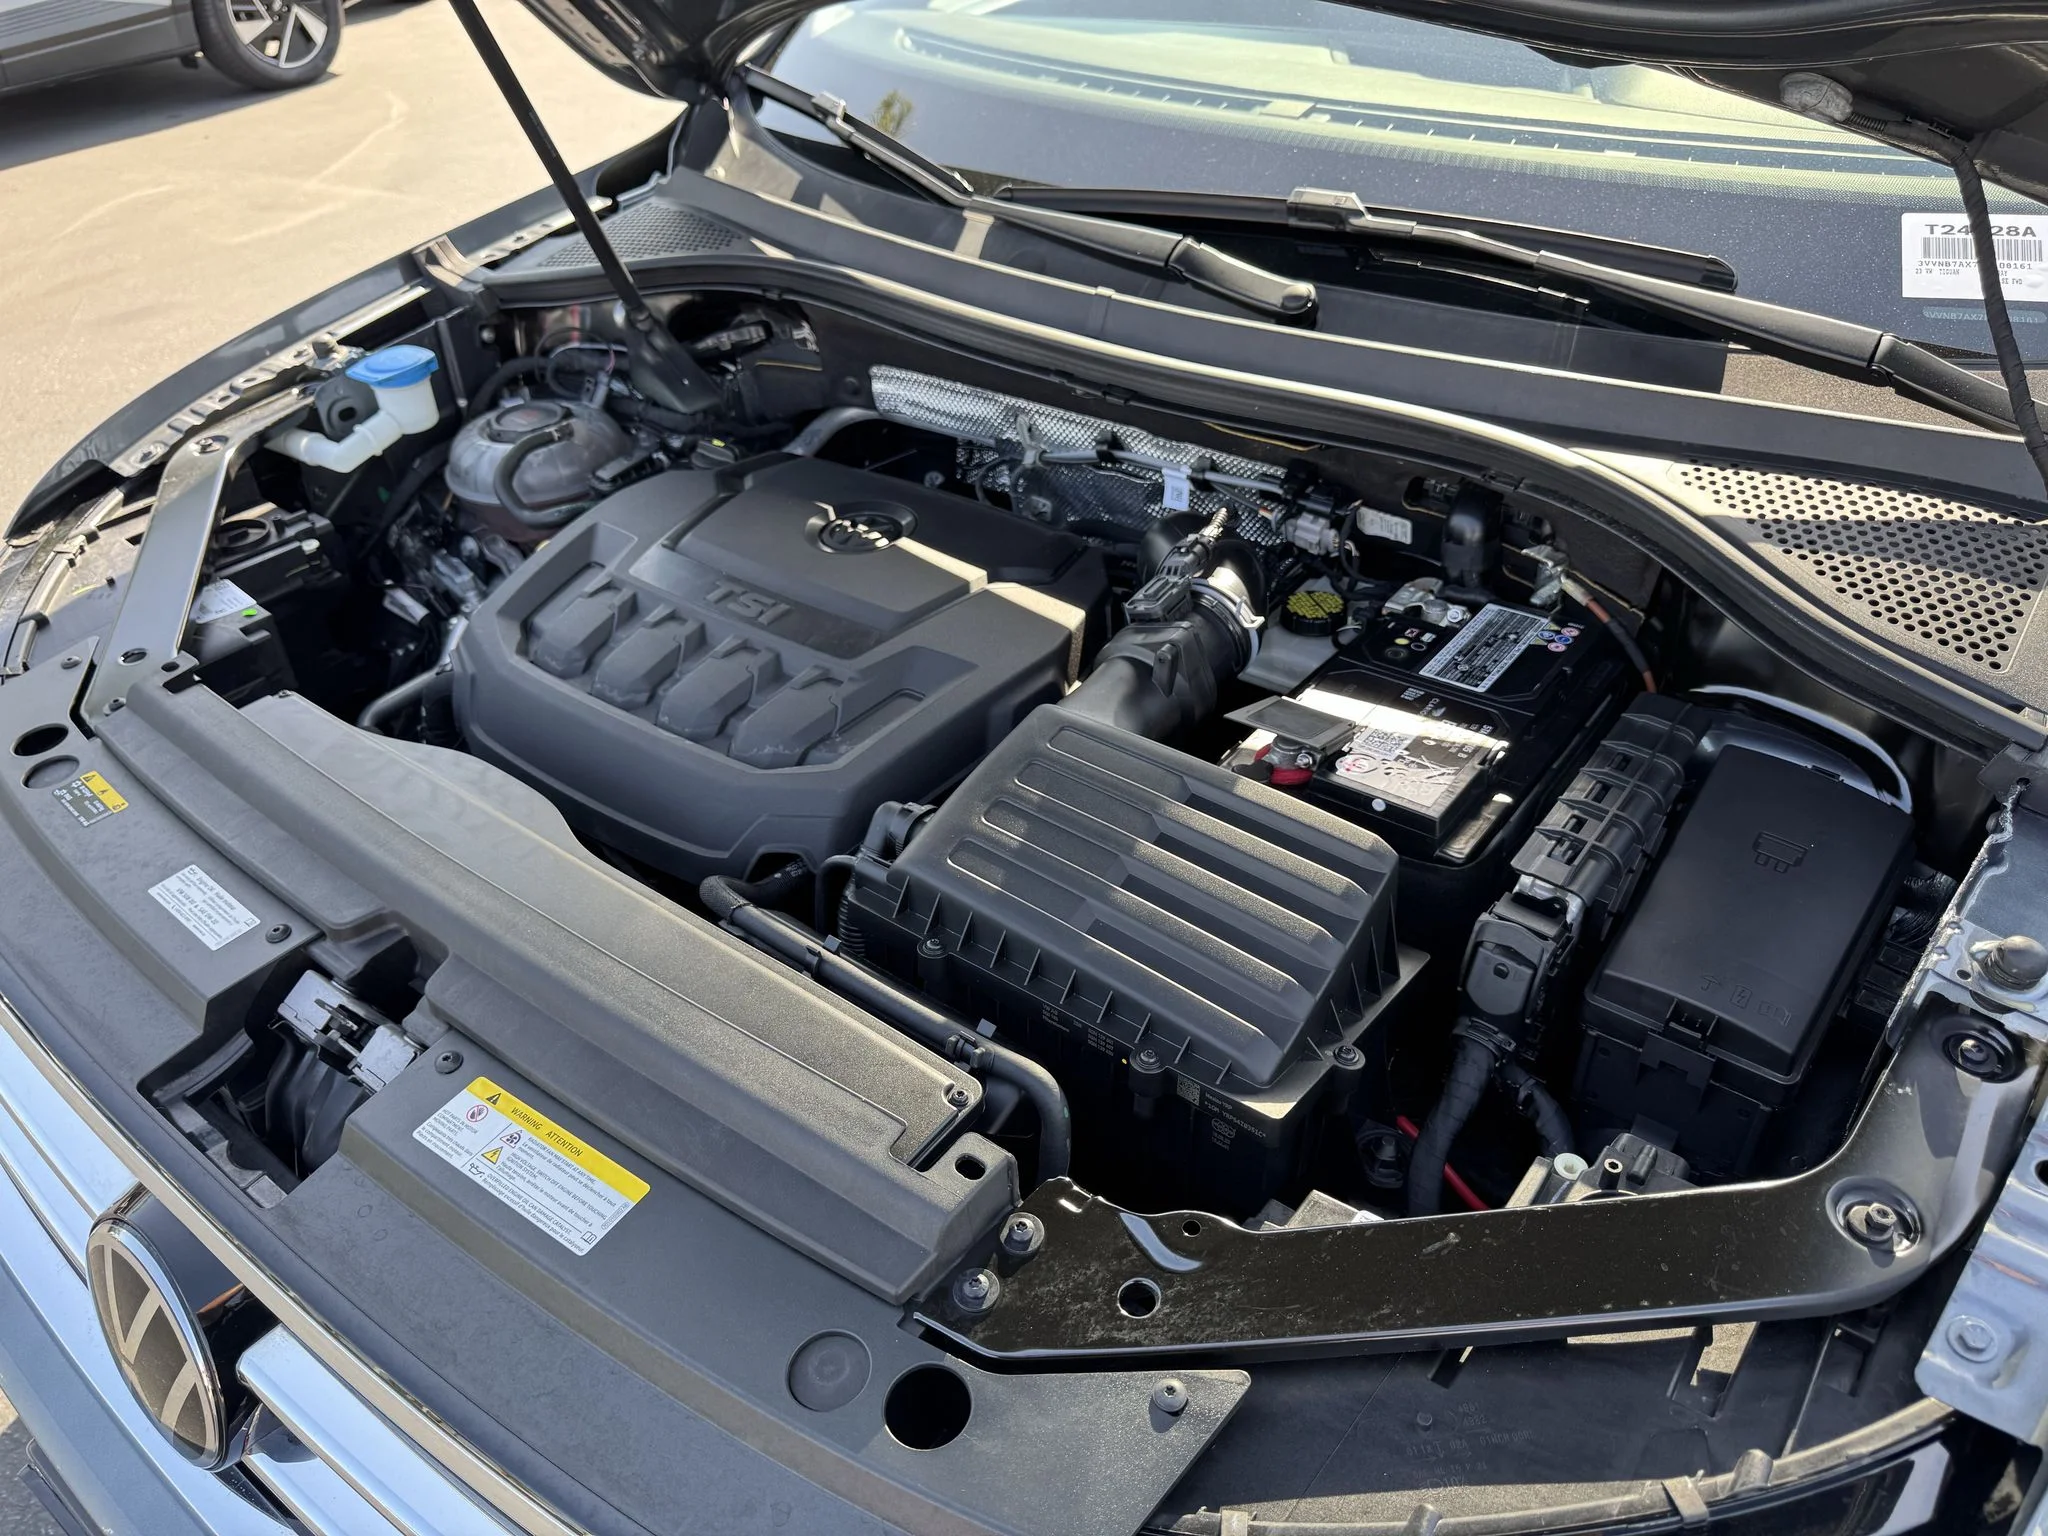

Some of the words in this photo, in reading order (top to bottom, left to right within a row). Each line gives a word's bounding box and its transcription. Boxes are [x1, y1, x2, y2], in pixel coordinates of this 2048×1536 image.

[1924, 224, 2037, 237] T2428A
[705, 581, 791, 627] TSI
[509, 1106, 543, 1131] WARNING
[544, 1129, 584, 1157] ATTENTION
